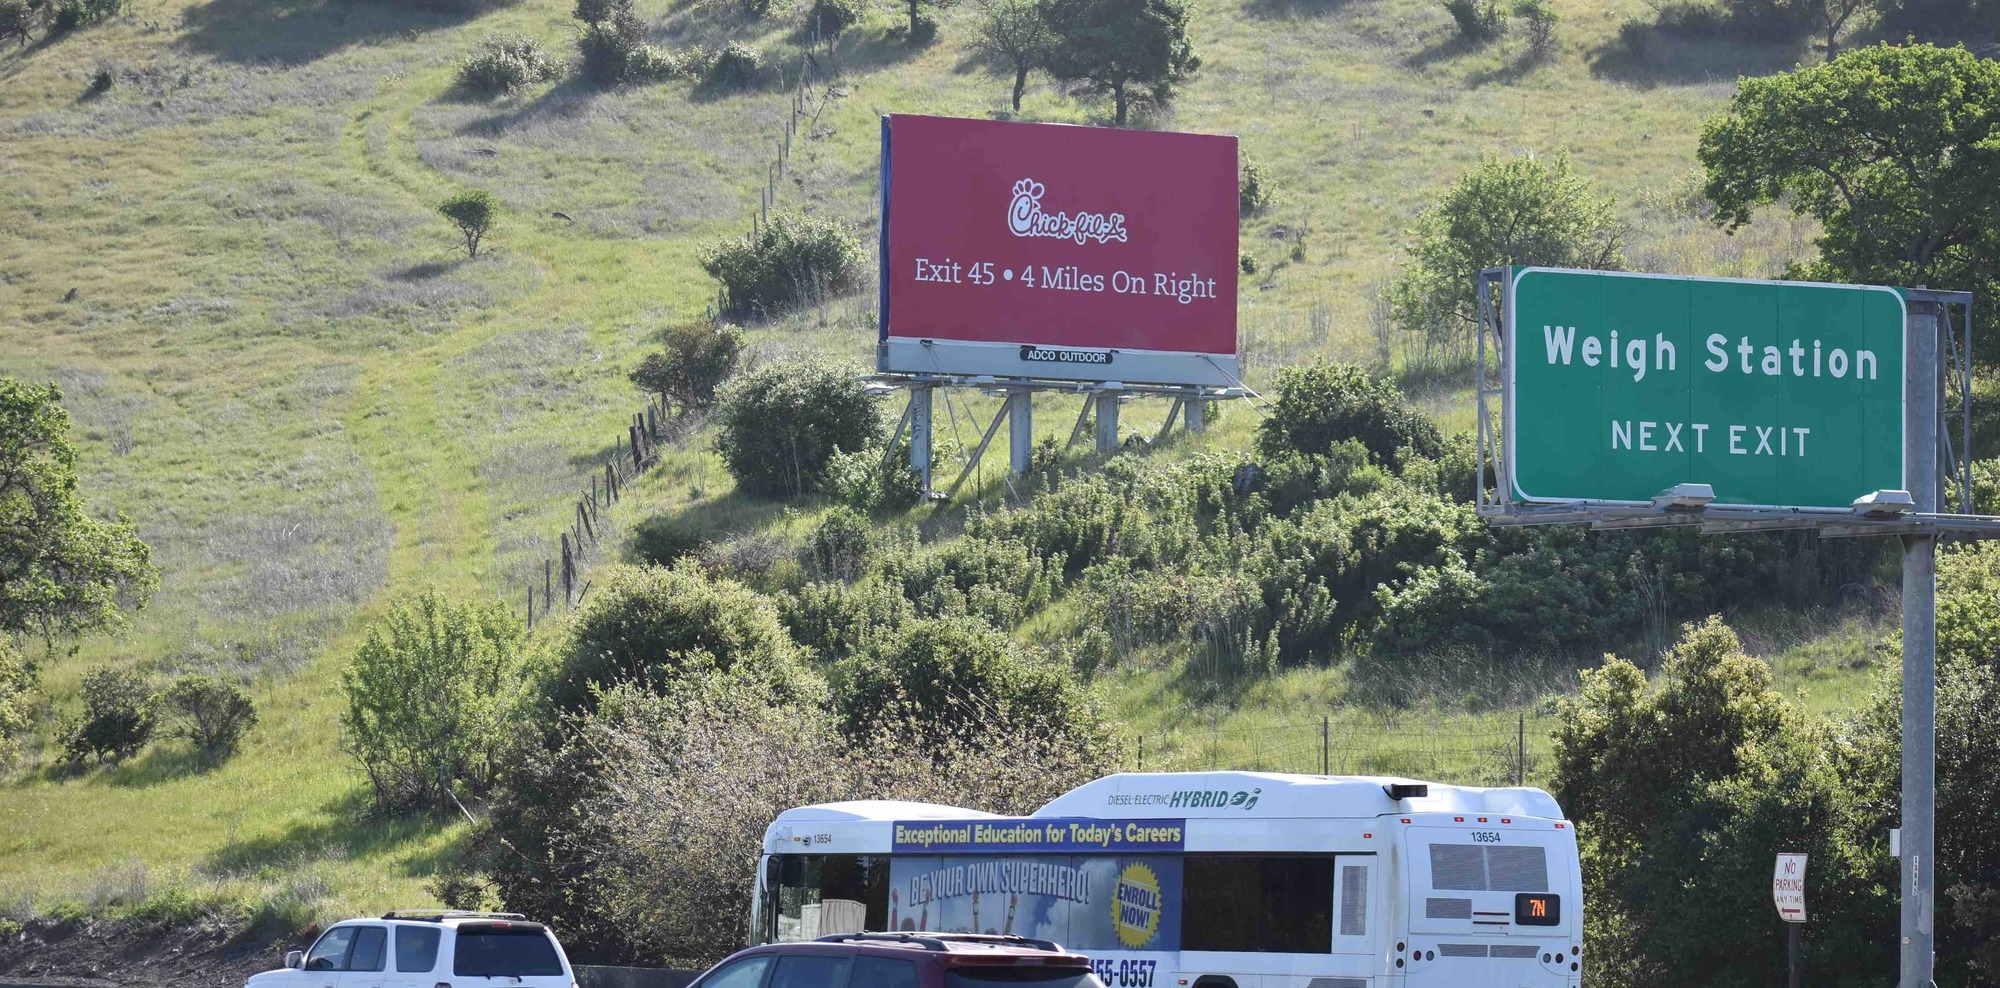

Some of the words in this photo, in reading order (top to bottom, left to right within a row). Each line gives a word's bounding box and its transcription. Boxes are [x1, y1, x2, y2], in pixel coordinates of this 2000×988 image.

[1008, 178, 1127, 245] Chick-fil-A
[914, 258, 961, 283] Exit
[968, 262, 994, 284] 45
[1021, 265, 1035, 287] 4
[1041, 266, 1104, 292] Miles
[1112, 271, 1146, 294] On
[1153, 272, 1216, 304] Right
[1028, 350, 1056, 360] ADCO
[1060, 351, 1106, 362] OUTDOOR
[1543, 325, 1676, 382] Weigh
[1704, 333, 1877, 380] Station
[1612, 420, 1709, 453] NEXT
[1729, 425, 1810, 457] EXIT
[1169, 791, 1229, 808] HYBRID
[896, 825, 970, 847] Exceptional
[974, 824, 1042, 843] Education
[1046, 824, 1066, 842] for
[1069, 823, 1122, 847] Today's
[1125, 823, 1181, 843] Careers
[1471, 832, 1501, 842] 13654
[1785, 862, 1796, 874] NO
[910, 874, 928, 907] BE
[929, 865, 964, 901] YOUR
[966, 862, 998, 894] OWN
[1000, 862, 1091, 904] SUPERHERO!
[1117, 883, 1157, 910] ENROLL
[1776, 879, 1801, 891] PARKING
[1530, 900, 1546, 916] 7N
[1776, 895, 1787, 903] ANY
[1789, 895, 1803, 904] TIME
[1121, 904, 1150, 929] NOW!
